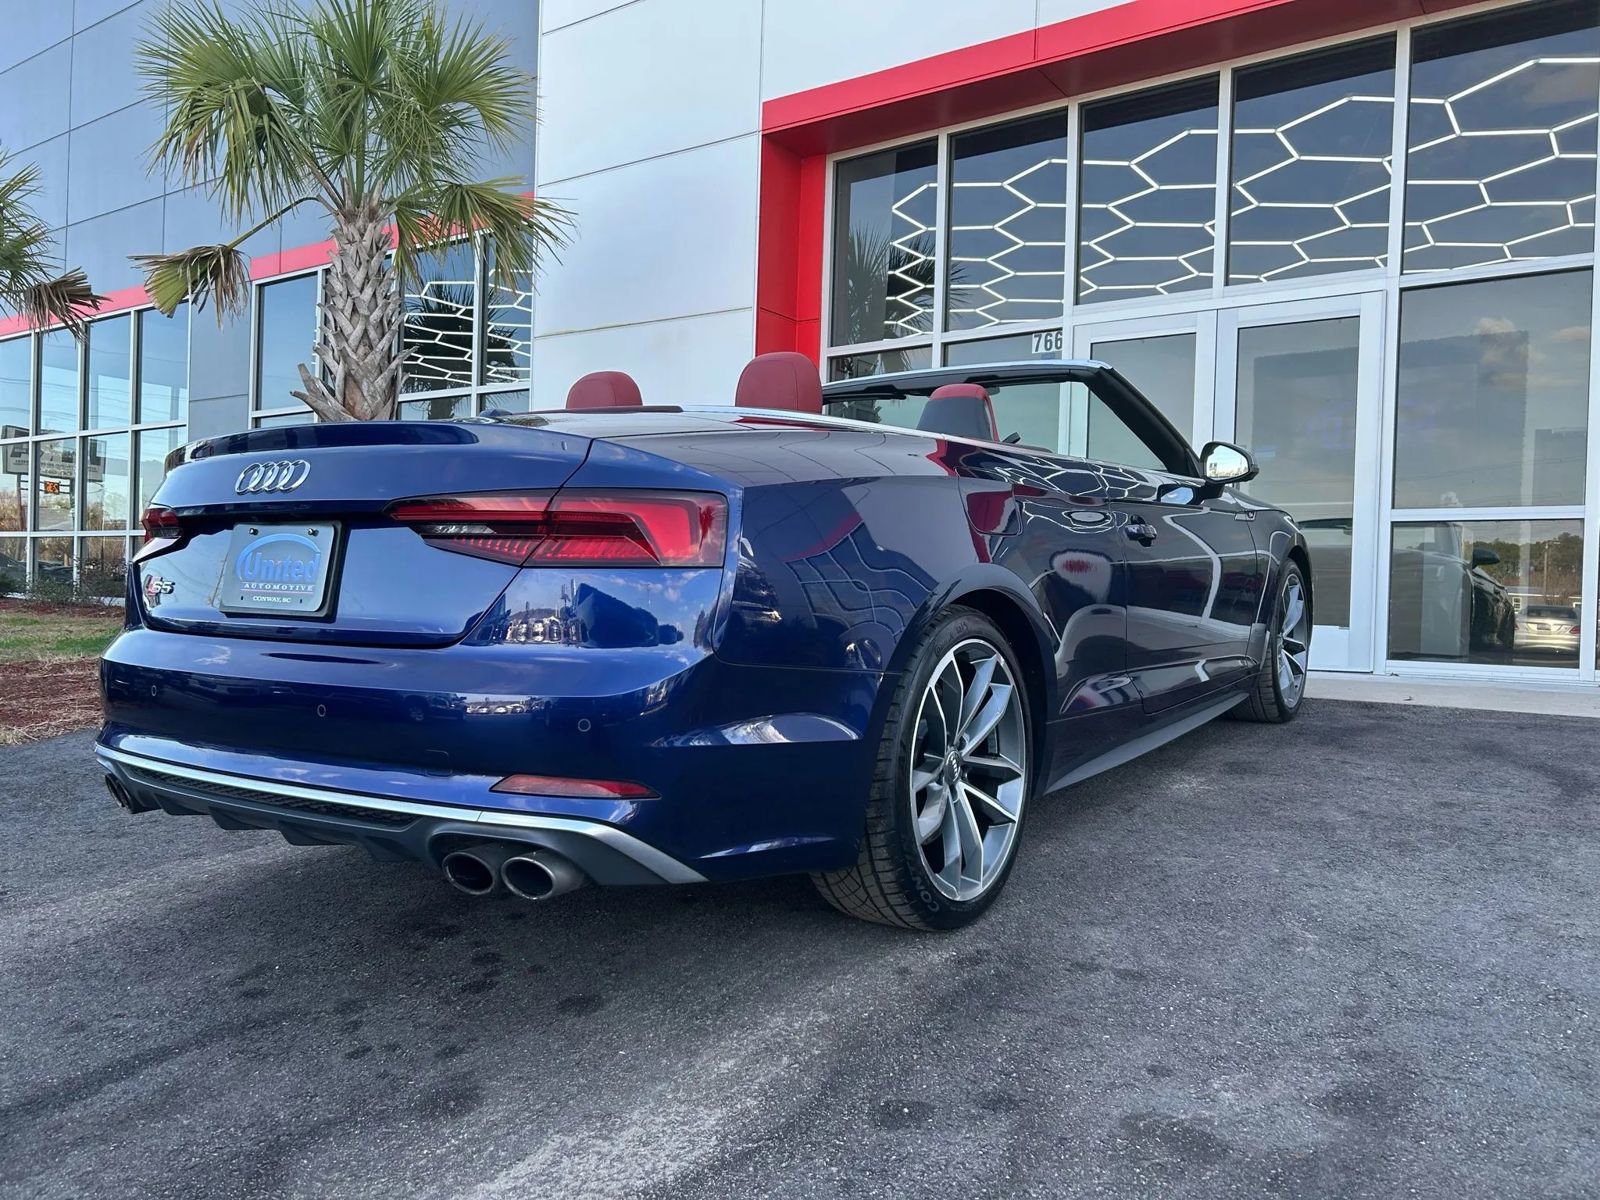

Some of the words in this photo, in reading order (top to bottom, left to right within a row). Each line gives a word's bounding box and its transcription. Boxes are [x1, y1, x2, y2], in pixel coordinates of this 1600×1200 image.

[1033, 331, 1063, 352] 766
[244, 552, 321, 582] United
[244, 583, 314, 591] AUTOMOTIVE
